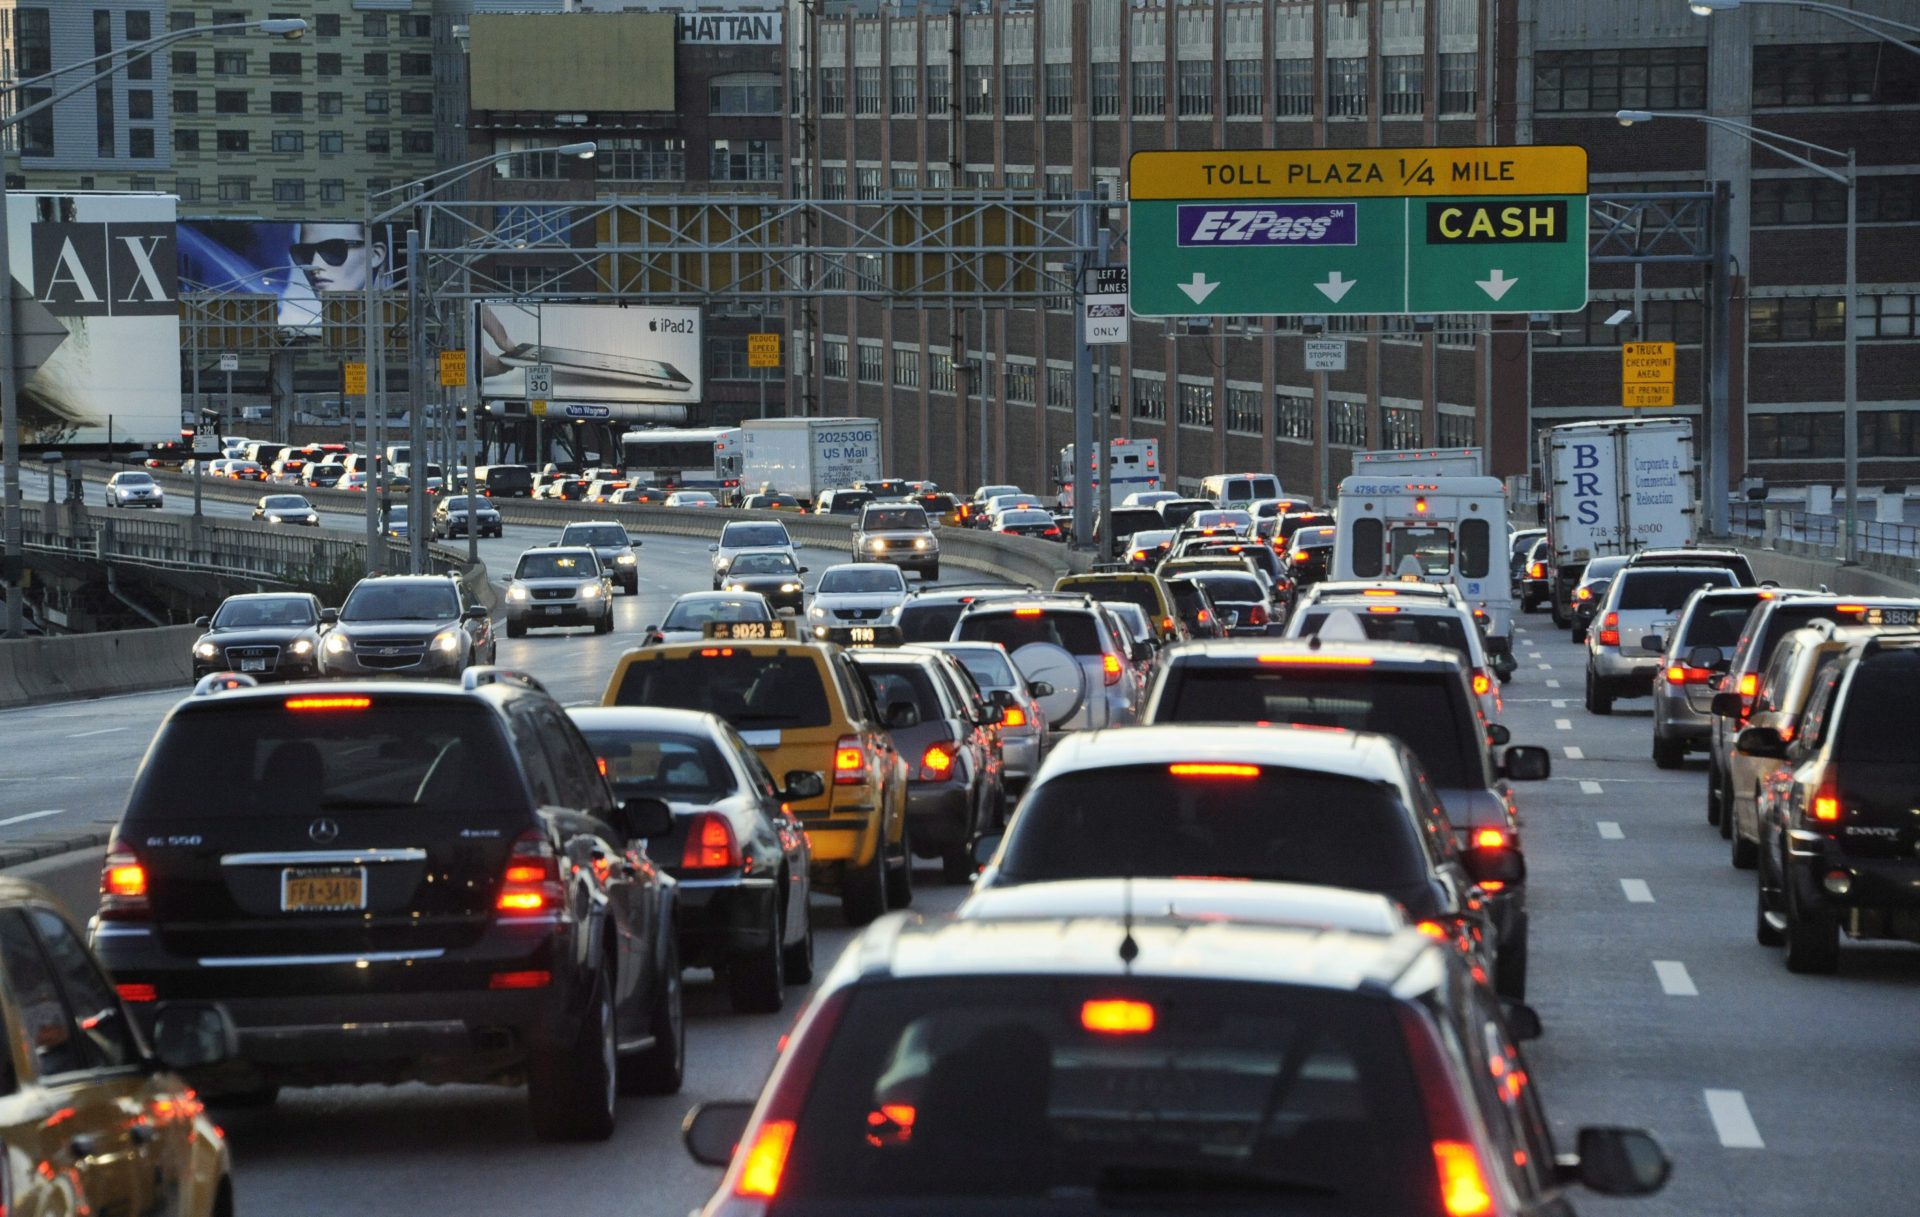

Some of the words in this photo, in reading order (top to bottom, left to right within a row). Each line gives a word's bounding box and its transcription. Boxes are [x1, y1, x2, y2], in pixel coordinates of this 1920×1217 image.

[680, 16, 773, 40] HATTAN
[1202, 164, 1271, 185] TOLL
[1288, 163, 1383, 184] PLAZA
[1452, 161, 1515, 182] MILE
[1191, 211, 1332, 241] E-ZPass
[1439, 207, 1554, 238] CASH
[1097, 269, 1117, 280] LEFT
[1120, 268, 1127, 280] 2
[1098, 283, 1127, 293] LANES
[660, 318, 684, 333] iPad
[687, 320, 694, 334] 2
[1093, 327, 1119, 337] ONLY
[1636, 345, 1663, 355] TRUCK
[531, 381, 548, 392] 30
[570, 406, 583, 414] Van
[584, 406, 607, 417] Wagner
[818, 430, 872, 444] 2025306
[823, 448, 840, 459] US
[844, 447, 868, 458] Mail
[1635, 458, 1670, 474] Corporate
[1672, 456, 1679, 470] &
[1635, 476, 1677, 488] Commercial
[1636, 491, 1674, 505] Relocation
[1885, 611, 1915, 624] 3B84
[732, 623, 765, 639] 9D23
